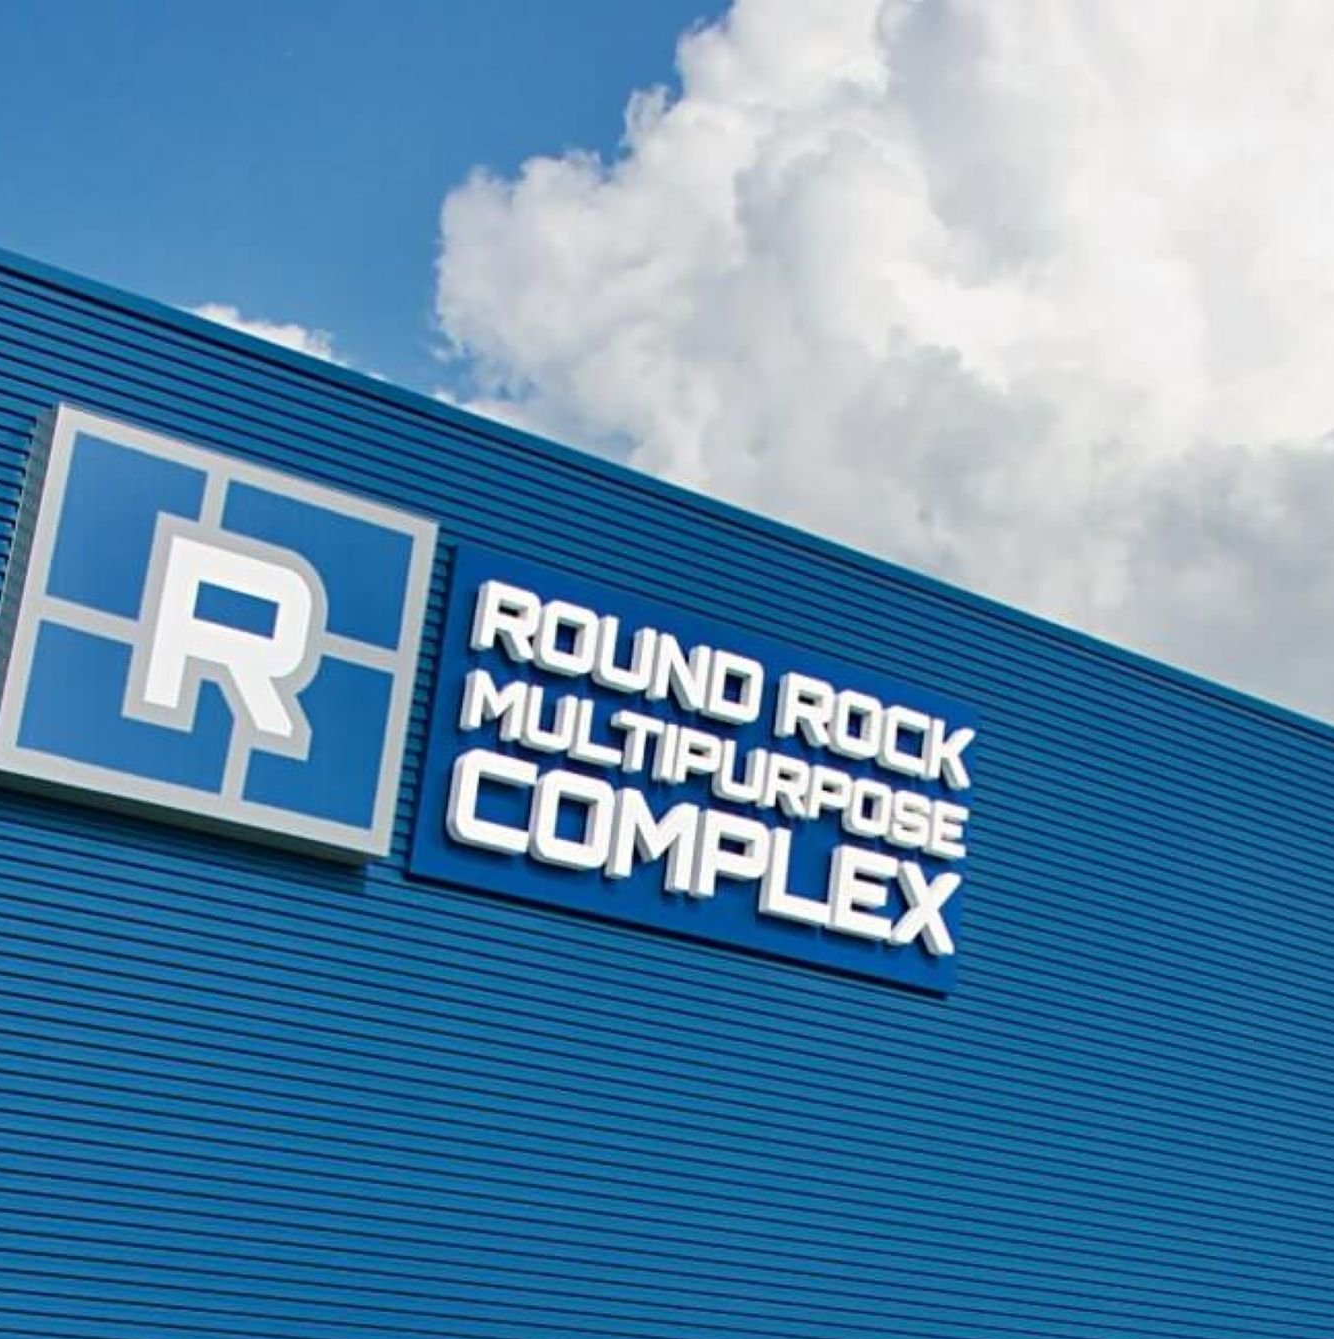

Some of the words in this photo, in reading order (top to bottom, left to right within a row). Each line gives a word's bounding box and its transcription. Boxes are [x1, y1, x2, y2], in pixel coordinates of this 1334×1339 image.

[143, 535, 312, 739] R
[470, 579, 764, 726] ROUND
[775, 671, 975, 791] ROCK
[447, 748, 961, 956] COMPLEX
[460, 669, 968, 859] MULTIPURPOSE
